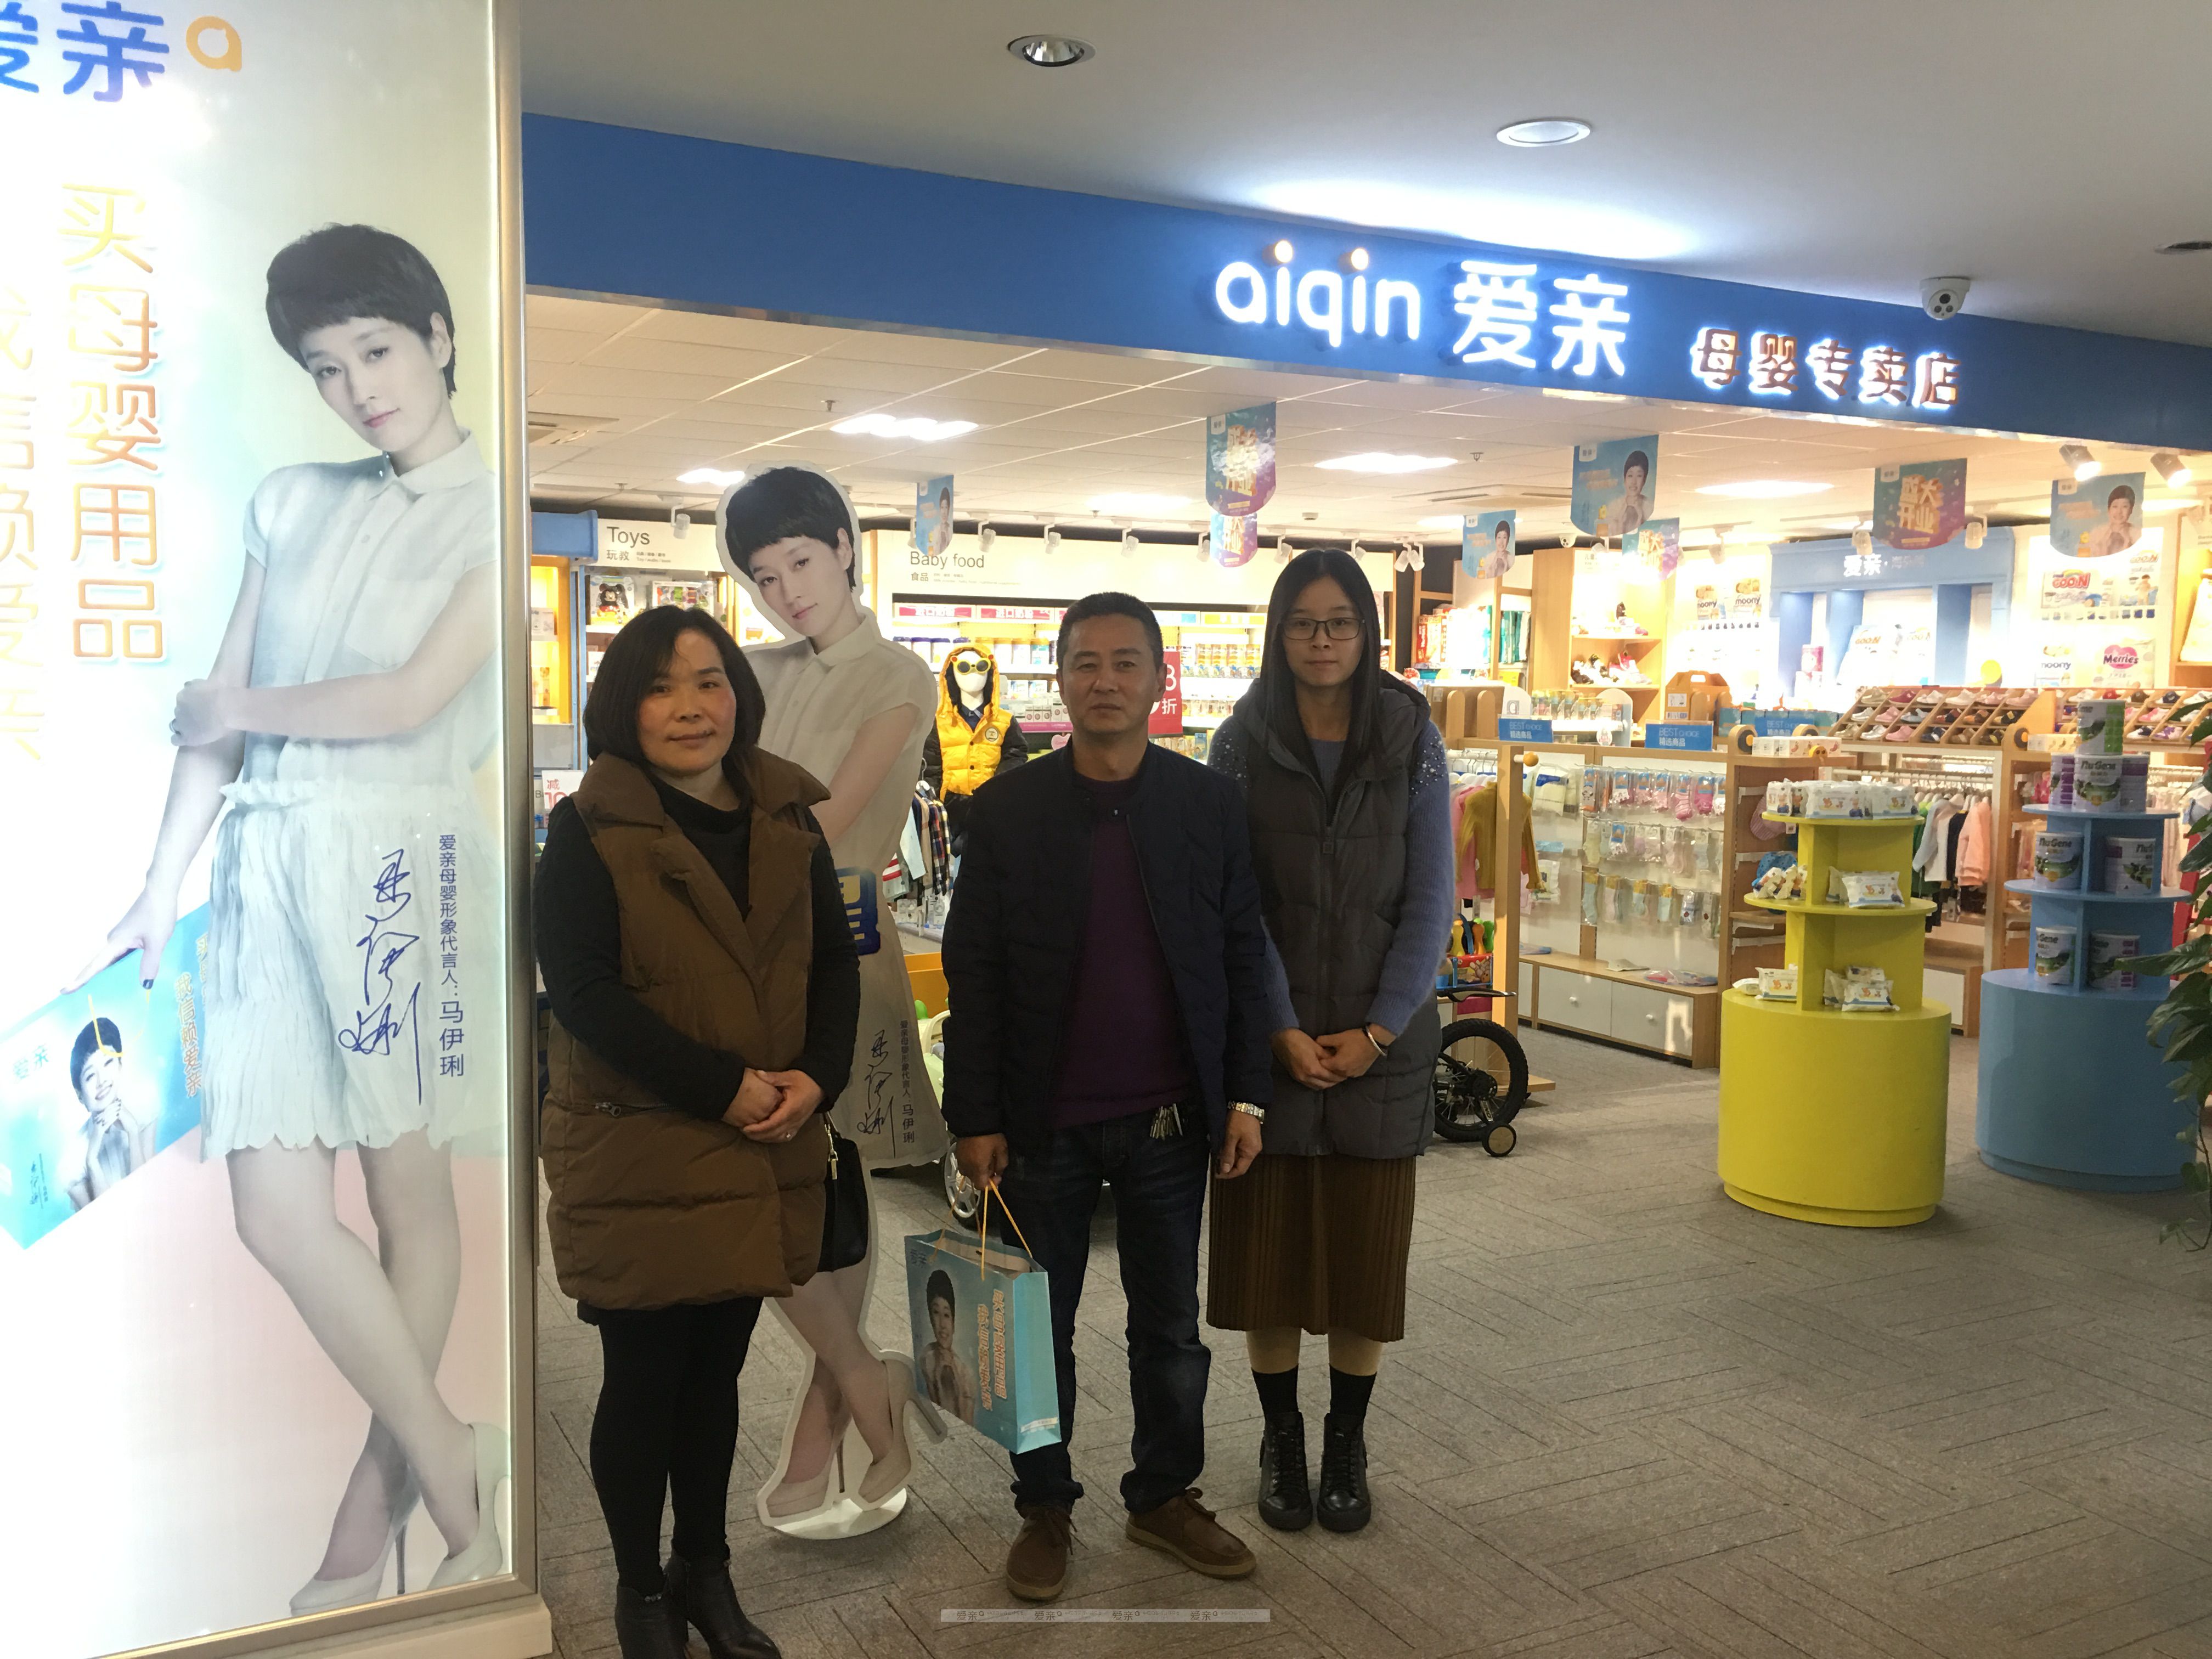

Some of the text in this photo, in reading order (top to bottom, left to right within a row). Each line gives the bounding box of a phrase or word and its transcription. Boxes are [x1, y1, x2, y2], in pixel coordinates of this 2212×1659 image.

[1214, 238, 1631, 377] aiqin 爱亲
[1692, 325, 1962, 409] 母婴专卖店
[57, 182, 164, 659] 买母婴用品
[606, 526, 650, 548] Toys
[606, 549, 630, 561] 玩教
[910, 551, 985, 569] Baby food
[911, 572, 929, 582] 食品
[2103, 653, 2139, 665] Merries
[1161, 697, 1178, 715] 折
[1509, 721, 1526, 730] BEST
[1767, 720, 1784, 729] BEST
[1658, 727, 1678, 737] BEST
[1658, 737, 1686, 747] 精选商品
[546, 778, 560, 791] 减
